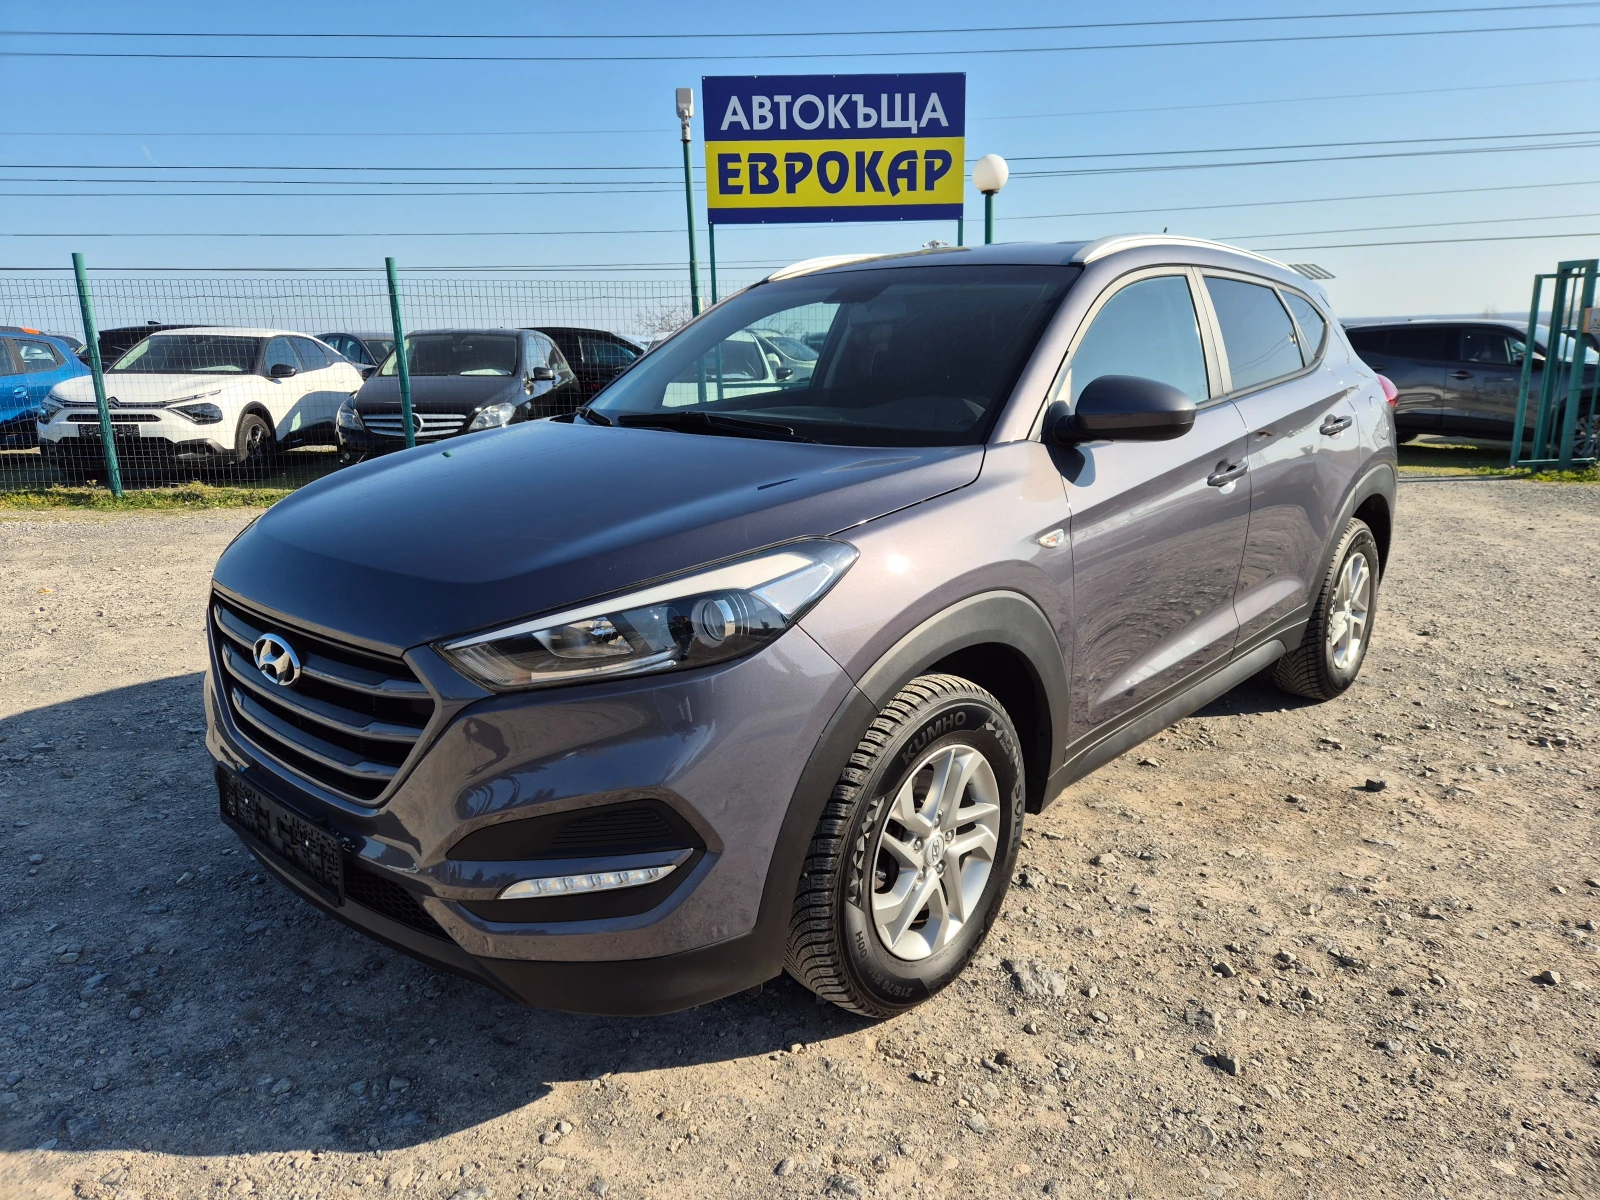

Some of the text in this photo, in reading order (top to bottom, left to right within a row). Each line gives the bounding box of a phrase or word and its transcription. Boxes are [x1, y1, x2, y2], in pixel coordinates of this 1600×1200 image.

[720, 92, 949, 134] АВТОКЪЩА
[717, 149, 953, 197] ЕВРОКАР
[901, 711, 967, 766] KUMHO
[882, 980, 914, 997] 215/70
